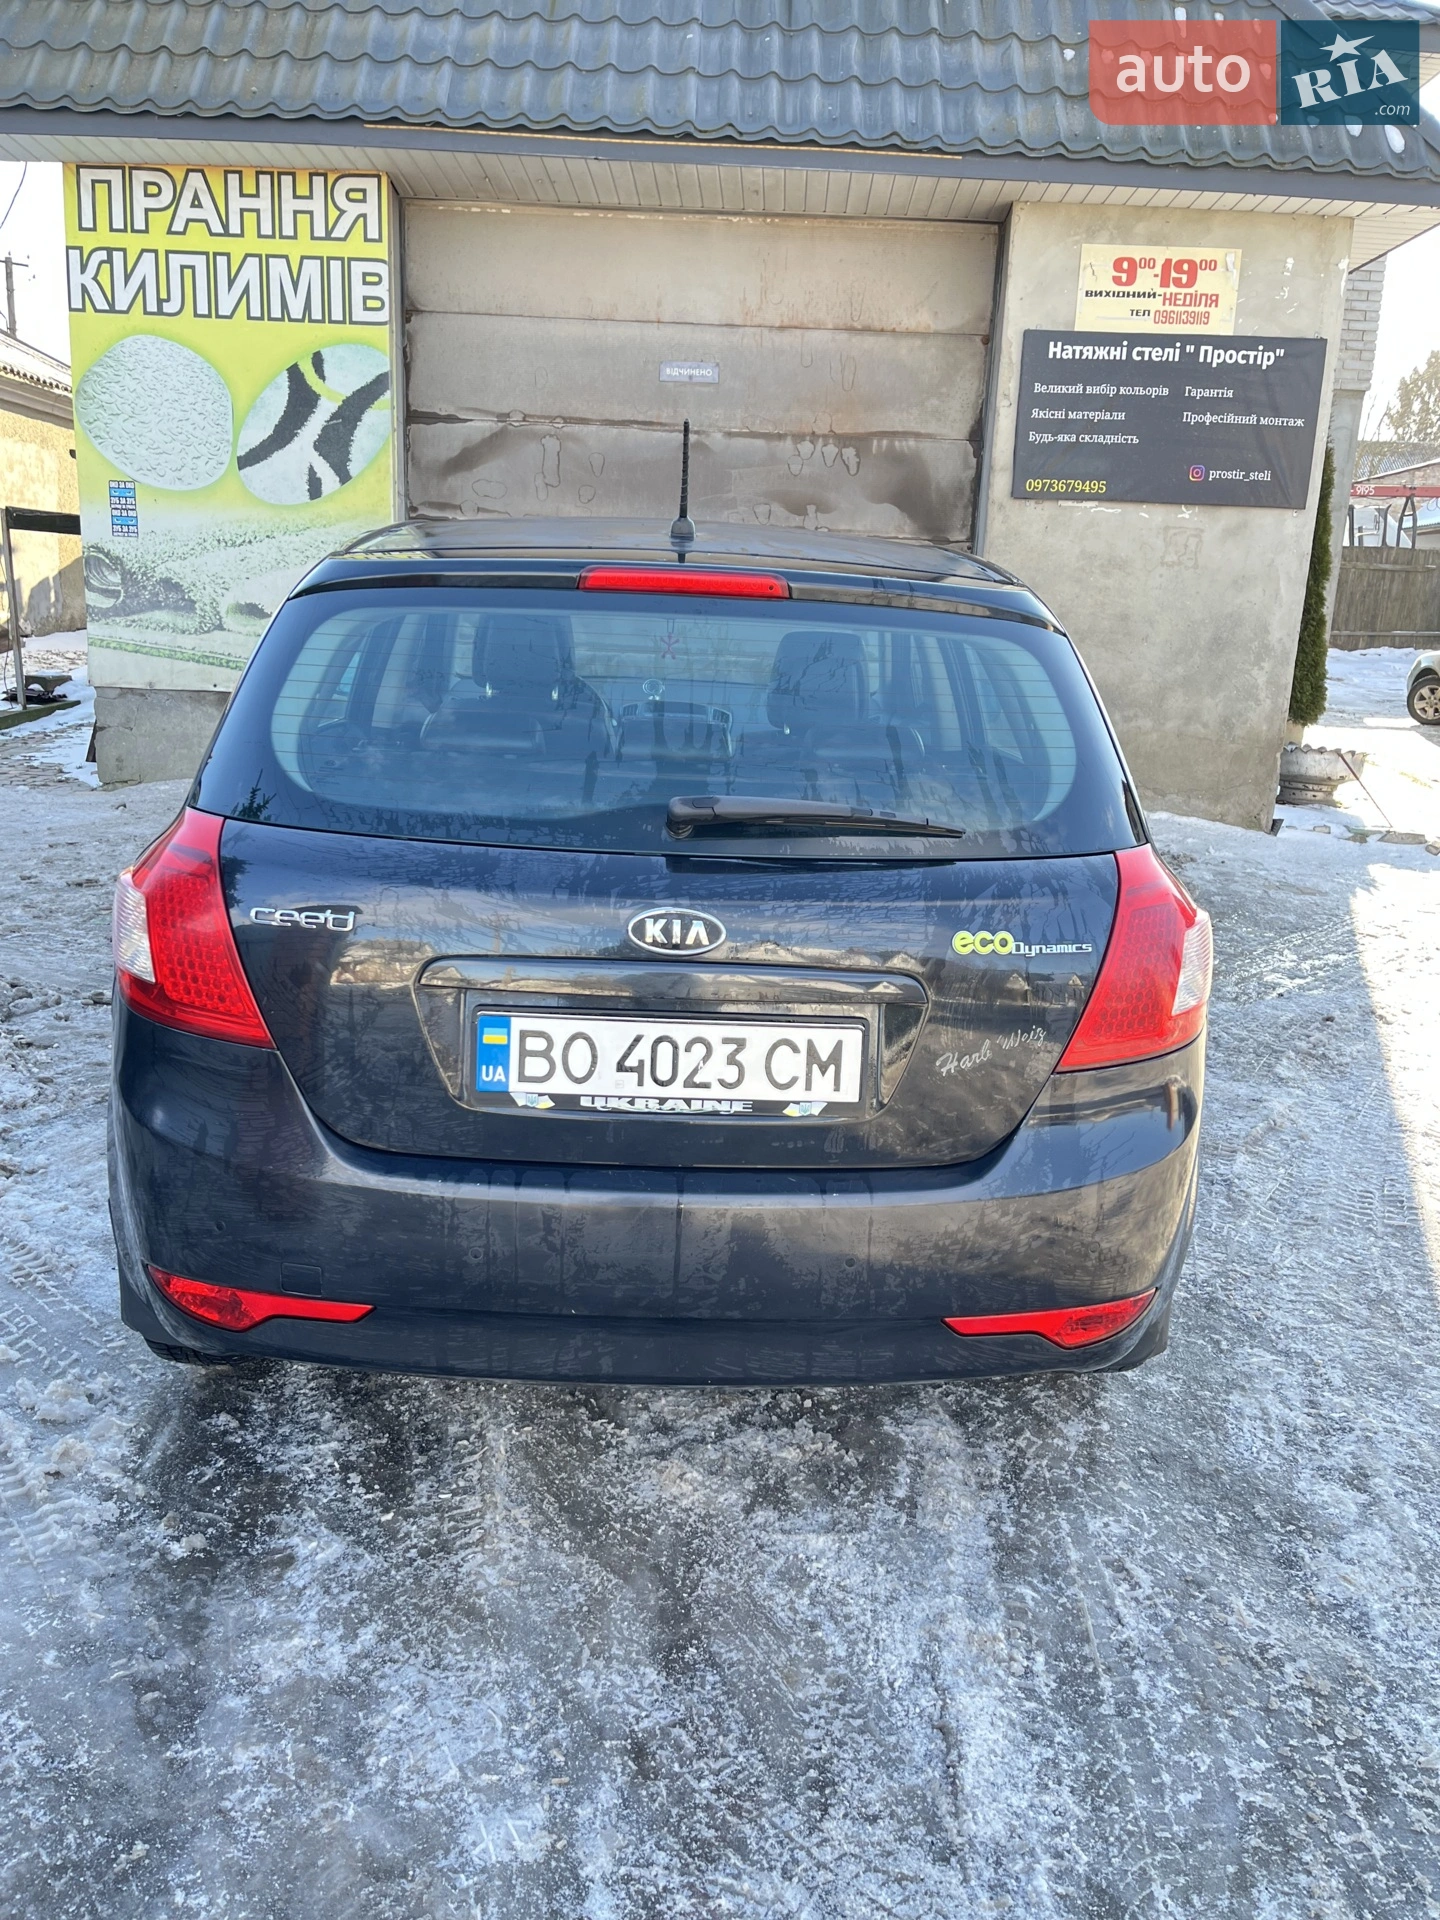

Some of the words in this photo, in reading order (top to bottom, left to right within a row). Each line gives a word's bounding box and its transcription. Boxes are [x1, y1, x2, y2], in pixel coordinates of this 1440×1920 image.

[76, 165, 383, 243] ПРАННЯ
[66, 246, 389, 325] КИЛИМІВ
[1130, 309, 1151, 317] ТЕЛ
[1153, 309, 1210, 325] 0961139119
[1048, 341, 1128, 361] Натяжні
[1132, 341, 1181, 361] стелі
[665, 367, 713, 377] ВІДЧИНЕНО
[1034, 382, 1083, 394] Великий
[1085, 384, 1117, 397] вибір
[1119, 385, 1169, 398] кольорів
[1184, 386, 1234, 400] Гарантія
[1031, 408, 1066, 419] Якісні
[1068, 409, 1126, 422] матеріали
[1182, 412, 1257, 426] Професійний
[1259, 415, 1305, 427] монтаж
[1028, 431, 1076, 444] Будь-яка
[1079, 433, 1139, 445] складність
[1208, 469, 1271, 482] prostir_steli
[1025, 478, 1107, 494] 0973679495
[644, 918, 710, 945] KIA
[518, 1029, 598, 1084] BO
[616, 1034, 747, 1090] 4023
[765, 1038, 843, 1092] CM
[481, 1065, 506, 1082] UA
[579, 1096, 753, 1114] UKRAINE
